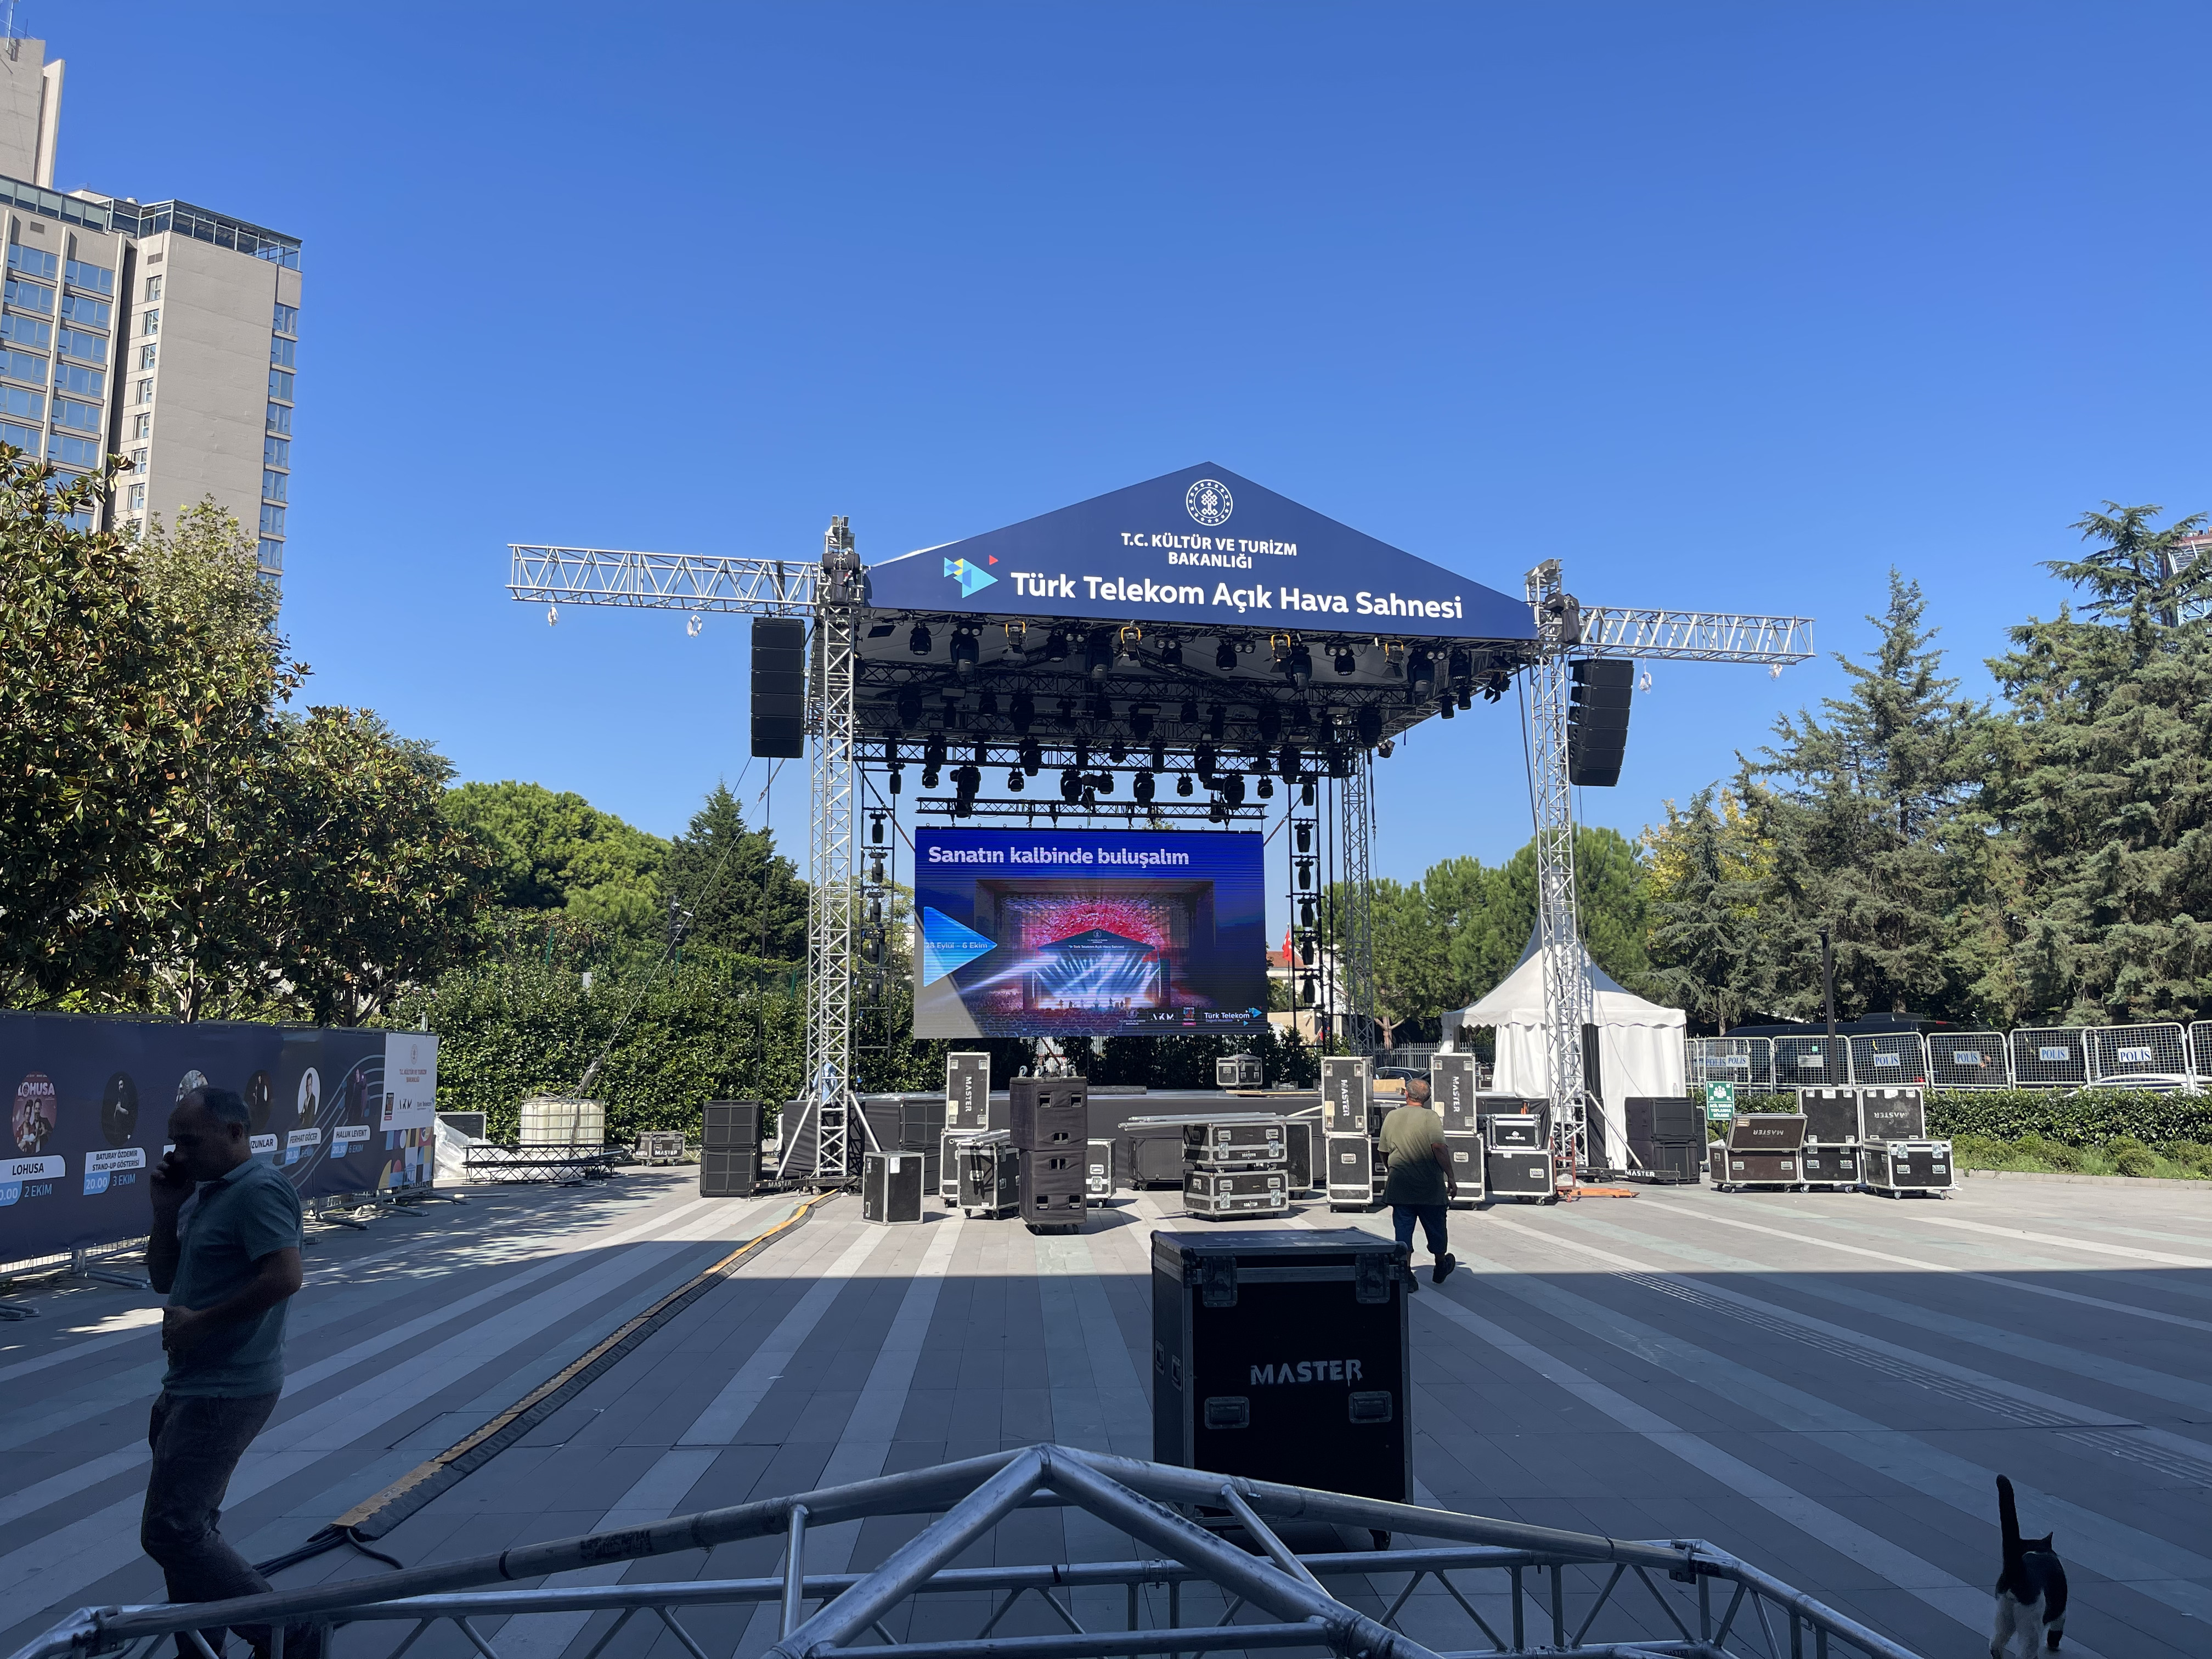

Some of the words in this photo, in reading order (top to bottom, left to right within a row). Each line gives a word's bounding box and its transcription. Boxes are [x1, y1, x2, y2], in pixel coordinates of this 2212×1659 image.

[1121, 533, 1148, 547] T.C.
[1152, 532, 1212, 550] KÜLTÜR
[1215, 538, 1235, 551] VE
[1238, 539, 1297, 556] TURİZM
[1169, 552, 1252, 569] BAKANLIĞI
[1011, 572, 1076, 599] Türk
[1083, 575, 1205, 605] Telekom
[1212, 583, 1273, 613] Açık
[1280, 586, 1350, 613] Hava
[1356, 591, 1463, 619] Sahnesi
[928, 847, 1004, 863] Sanatın
[1010, 847, 1093, 864] kalbinde
[1098, 848, 1189, 868] buluşalım
[1728, 1056, 1746, 1064] POLİS
[1875, 1054, 1898, 1065] POLİS
[1956, 1052, 1978, 1063] POLİS
[2041, 1047, 2065, 1059] POLİS
[2120, 1048, 2151, 1062] POLİS
[18, 1081, 55, 1098] LOHUSA
[1452, 1076, 1460, 1113] MASTER
[1341, 1079, 1350, 1116] MASTER
[336, 1130, 351, 1138] HALUK
[351, 1129, 367, 1137] LEVENT
[96, 1152, 116, 1161] BATURAY
[117, 1150, 138, 1159] ÖZDEMİR
[12, 1163, 44, 1176] LOHUSA
[92, 1163, 116, 1171] STAND-UP
[24, 1186, 29, 1198] 2
[31, 1182, 52, 1197] EKİM
[86, 1177, 108, 1190] 20.00
[112, 1176, 117, 1187] 3
[1250, 1359, 1363, 1386] MASTER
